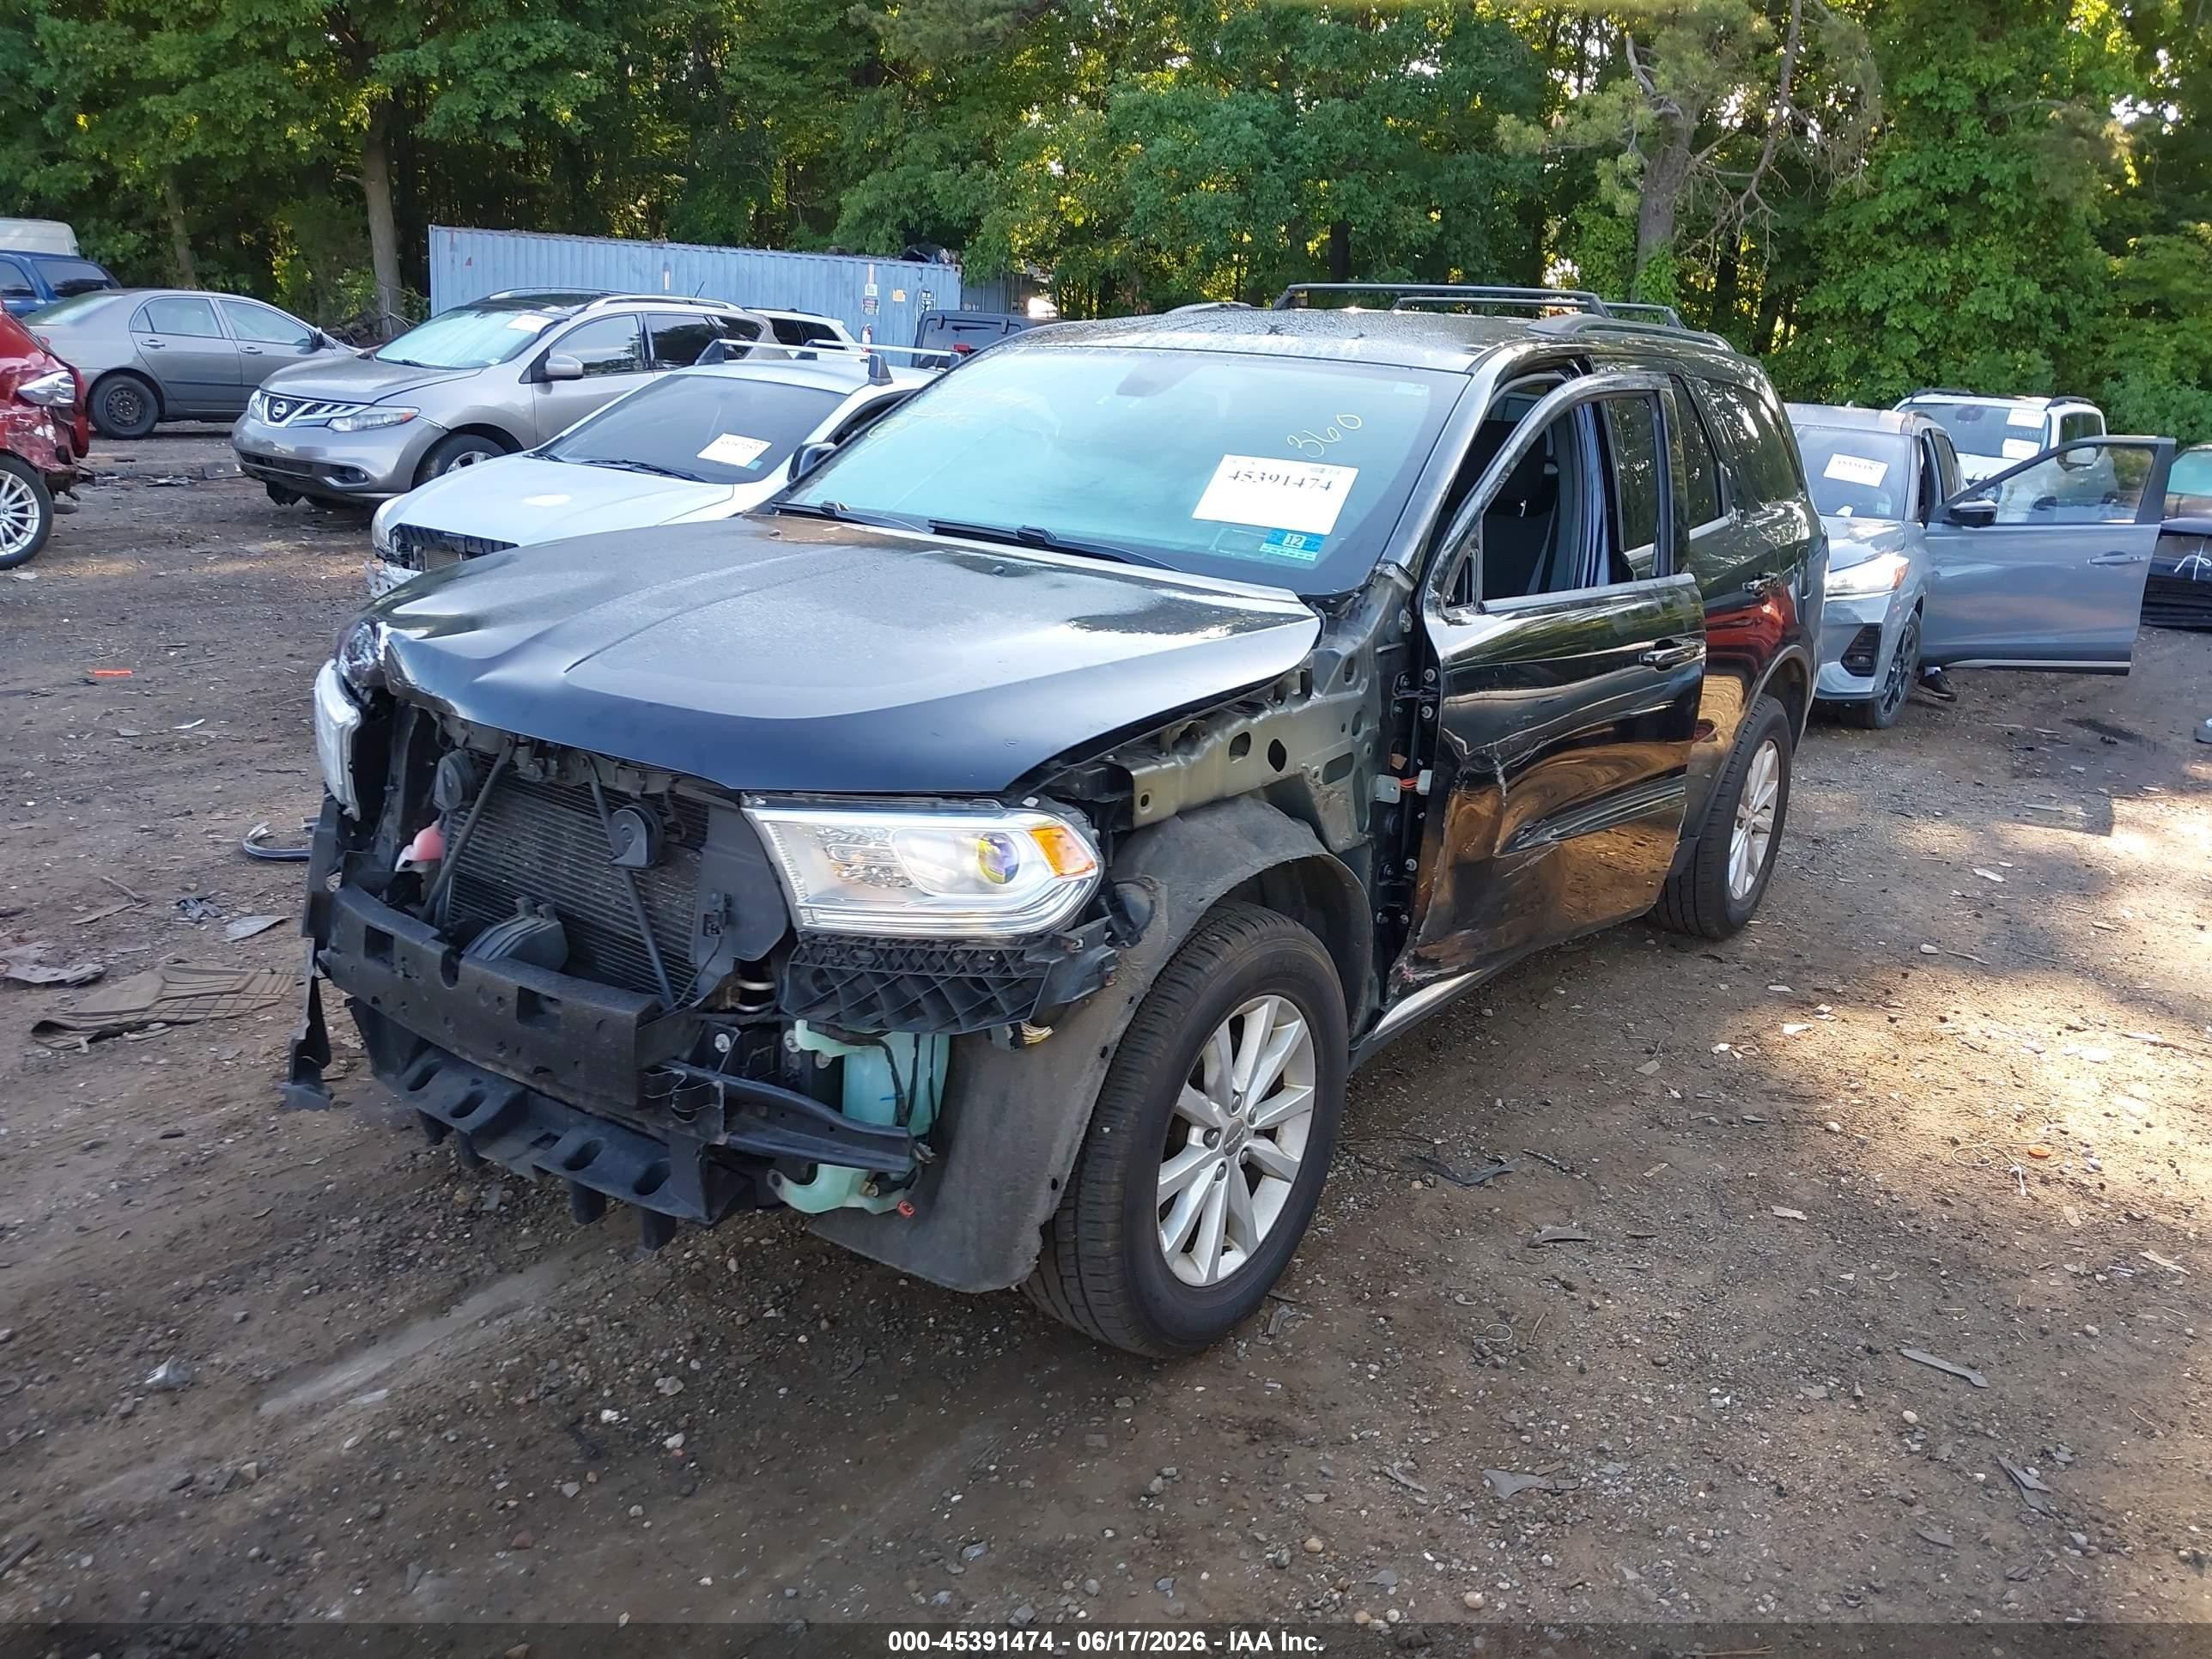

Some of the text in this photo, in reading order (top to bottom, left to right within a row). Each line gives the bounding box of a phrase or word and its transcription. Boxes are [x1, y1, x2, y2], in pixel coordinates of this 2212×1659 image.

[1286, 413, 1363, 459] 360
[1227, 469, 1333, 491] 45391474
[1285, 534, 1304, 547] 12
